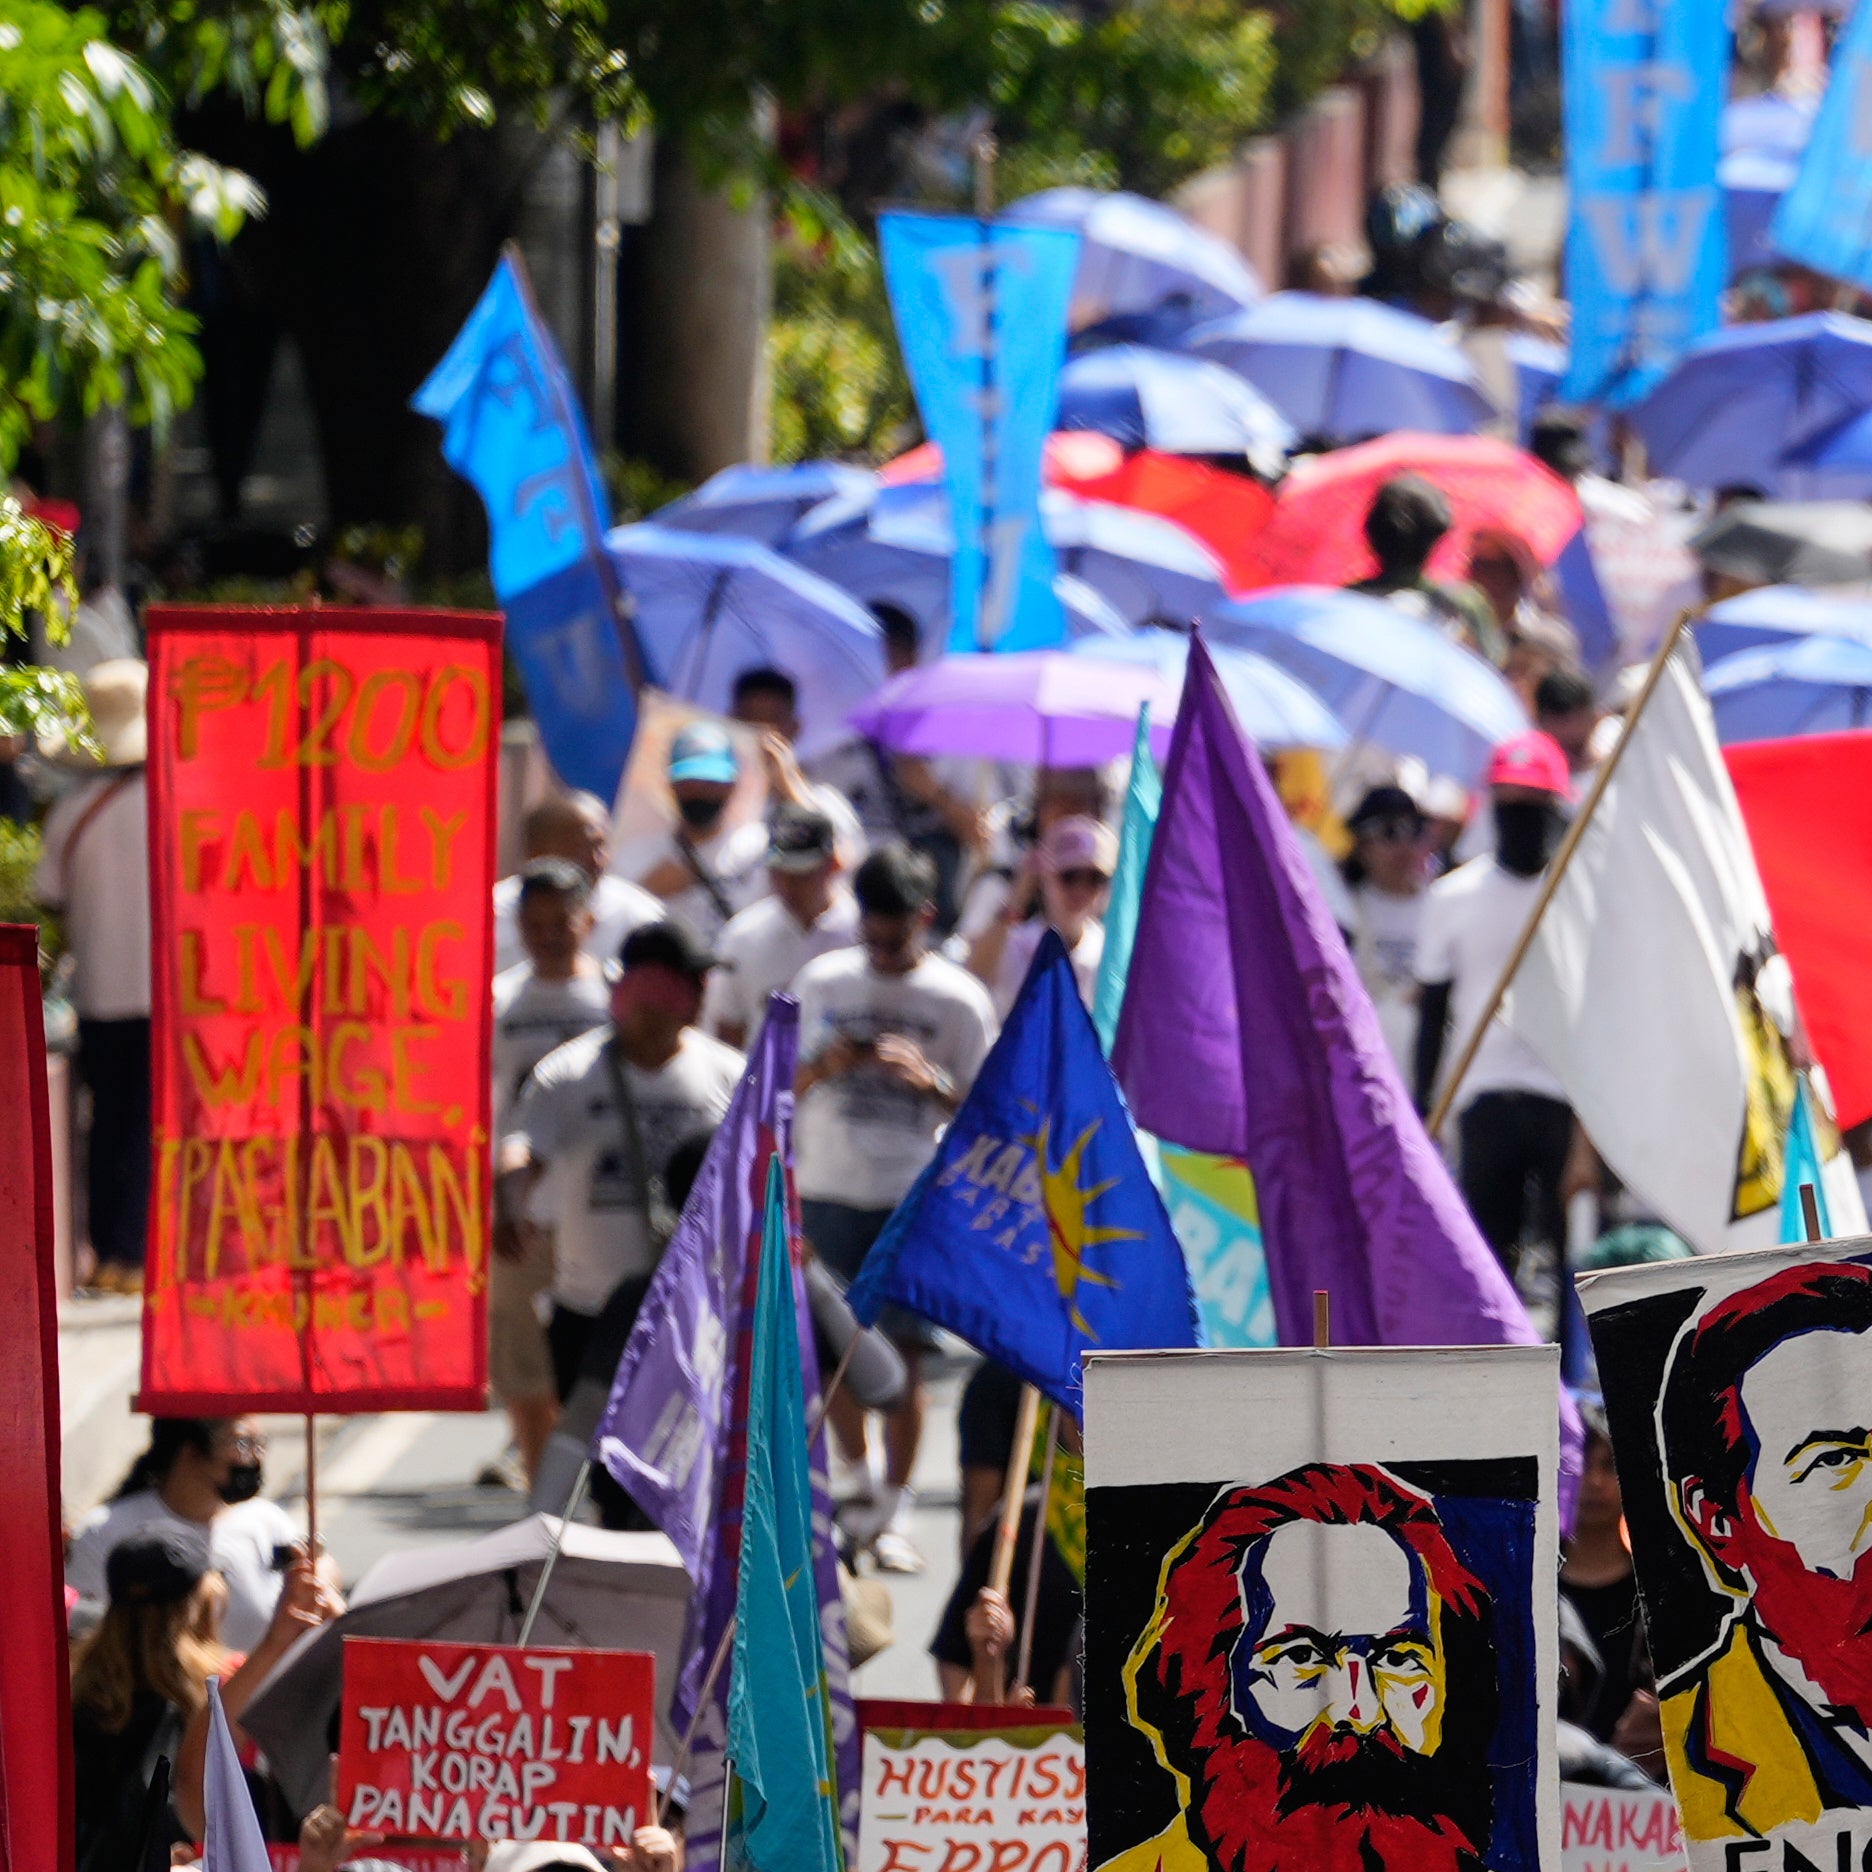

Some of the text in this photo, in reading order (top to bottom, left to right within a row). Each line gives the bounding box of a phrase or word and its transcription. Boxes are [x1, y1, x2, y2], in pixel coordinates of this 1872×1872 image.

[180, 806, 470, 893] FAMILY
[180, 920, 470, 1020] LIVING
[417, 1653, 574, 1711] VAT
[358, 1704, 641, 1769] TANGGALIN,
[409, 1756, 556, 1802] KORAP
[875, 1753, 1086, 1801] HUSTISY
[349, 1784, 636, 1847] PANAGUTIN
[913, 1806, 1083, 1826] PARA KAY
